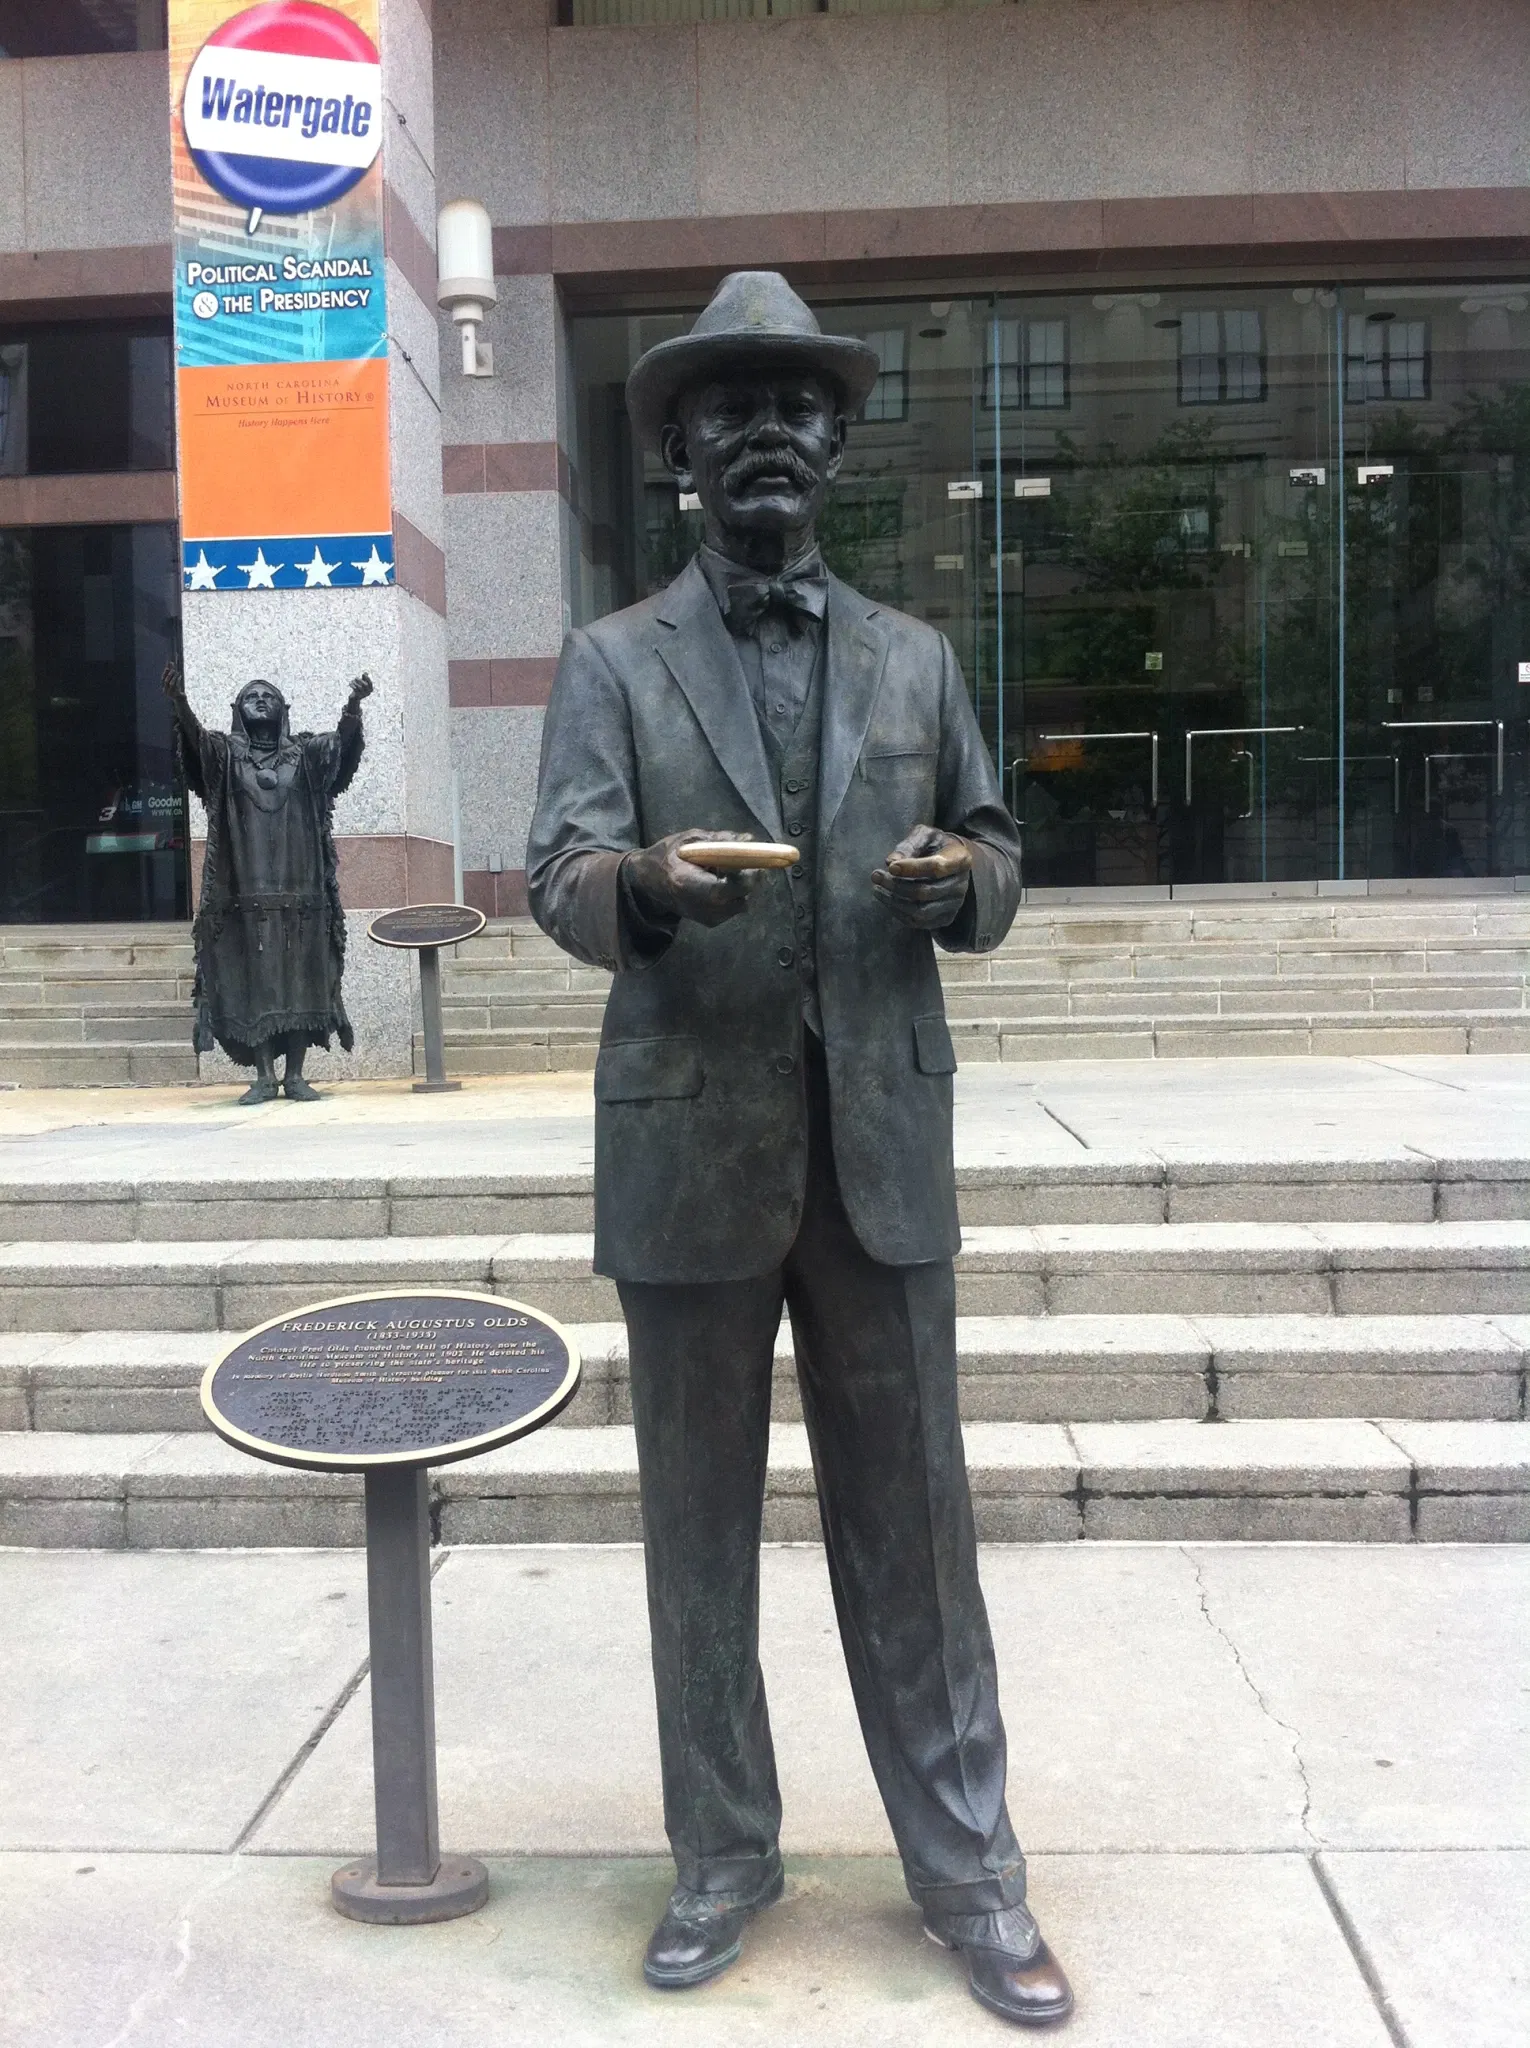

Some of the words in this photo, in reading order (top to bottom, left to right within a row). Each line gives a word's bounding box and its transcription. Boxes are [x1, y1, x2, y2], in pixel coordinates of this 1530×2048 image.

[201, 75, 372, 139] Watergate
[223, 296, 252, 313] THE
[226, 382, 269, 391] NORTH
[276, 379, 340, 389] CAROLINA
[238, 418, 268, 428] History
[271, 417, 308, 427] Happens
[99, 807, 116, 821] 3
[282, 1320, 378, 1332] FREDERICK
[386, 1318, 476, 1330] AUGUSTUS
[483, 1317, 529, 1328] OLDS
[354, 1344, 393, 1352] founded
